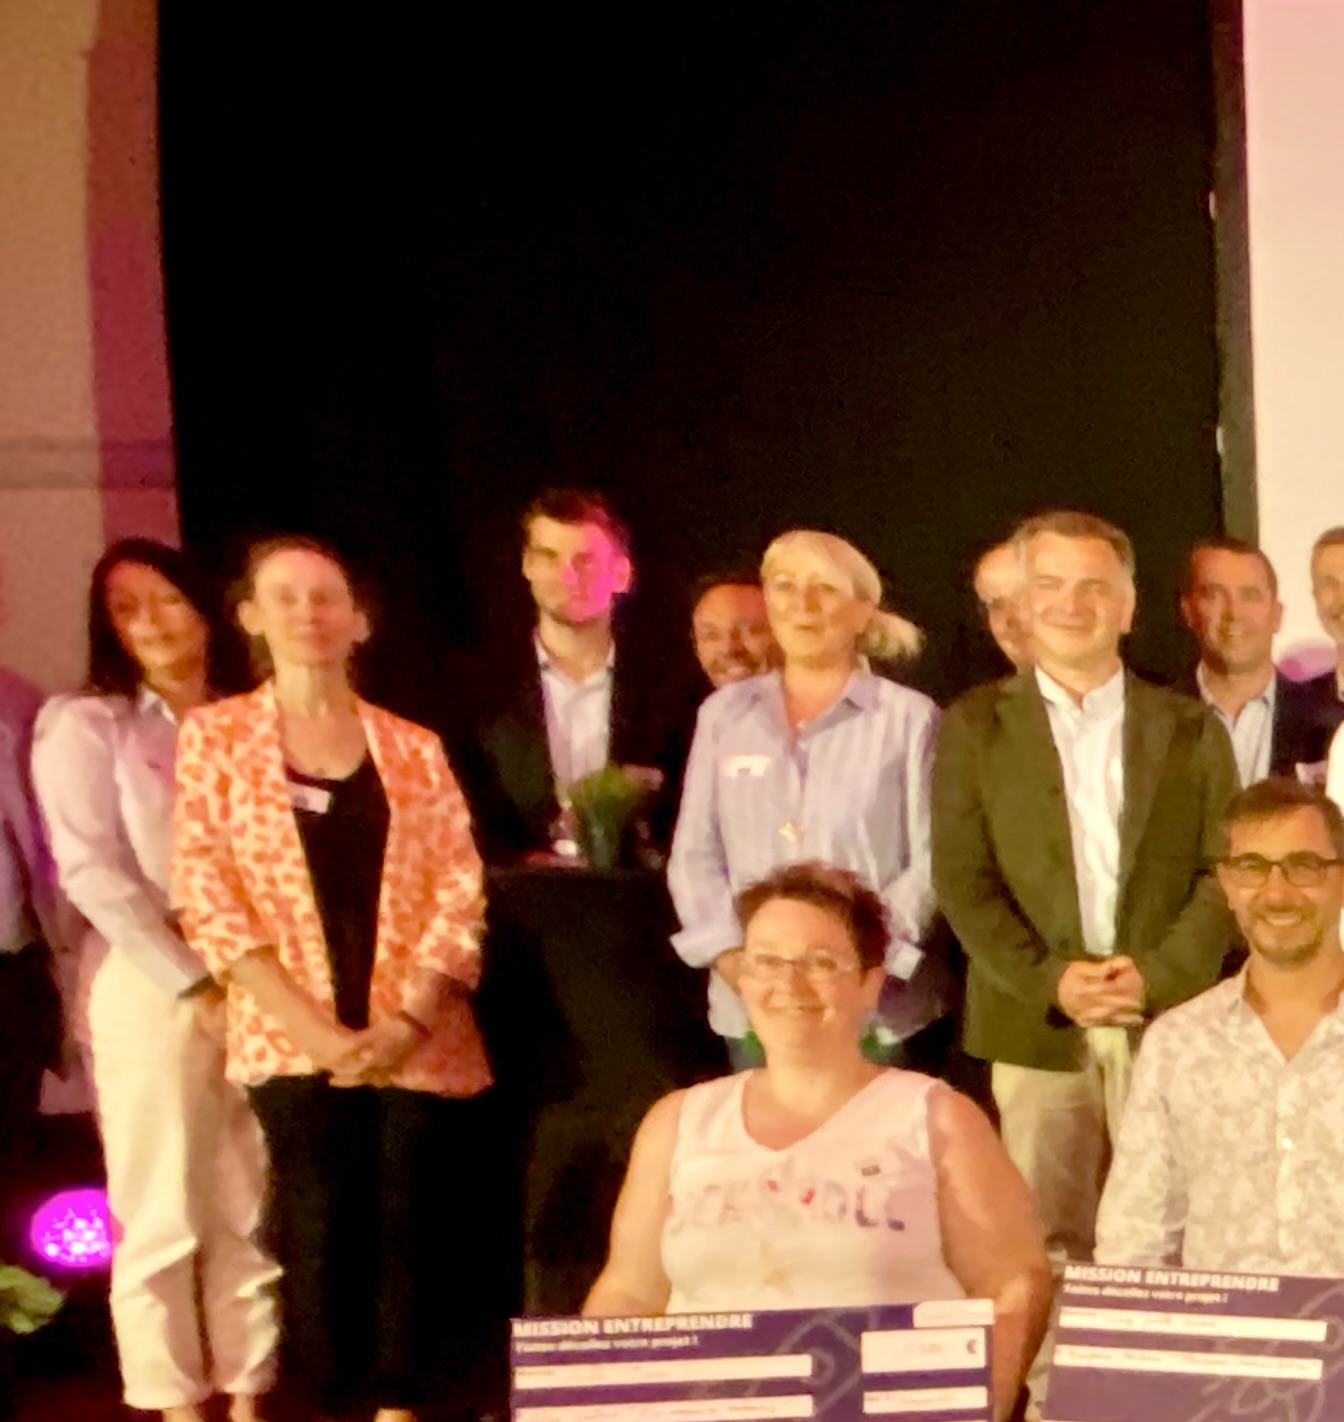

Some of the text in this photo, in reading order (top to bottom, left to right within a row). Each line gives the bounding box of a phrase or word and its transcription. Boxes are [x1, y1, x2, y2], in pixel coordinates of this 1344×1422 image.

[1064, 1265, 1280, 1292] MISSION ENTREPRENDRE
[512, 1313, 753, 1337] MISSION ENTREPRENDRE
[651, 1336, 690, 1349] projet
